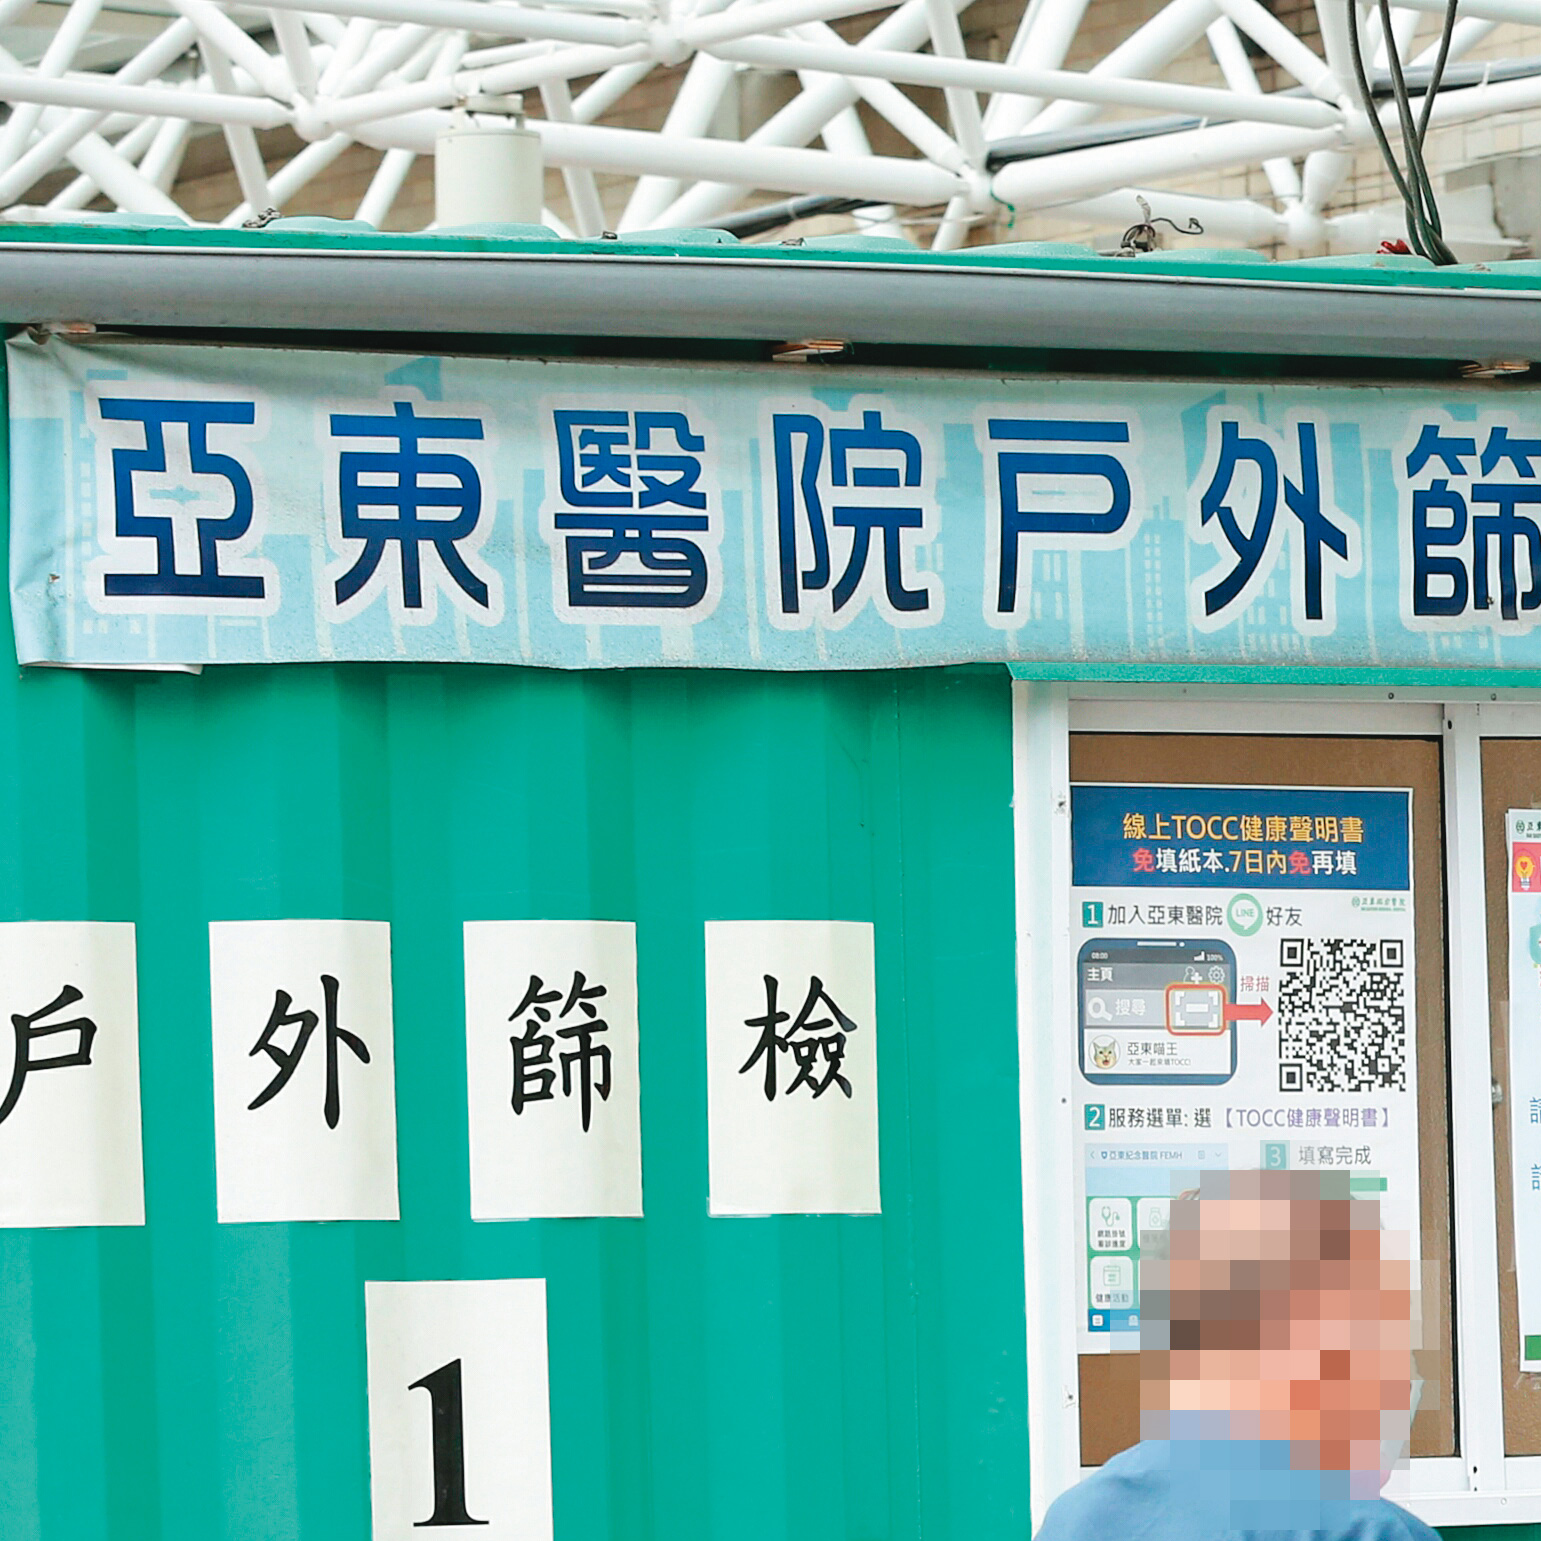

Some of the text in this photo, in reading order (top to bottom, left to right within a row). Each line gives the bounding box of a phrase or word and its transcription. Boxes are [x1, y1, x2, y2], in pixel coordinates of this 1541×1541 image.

[1122, 813, 1365, 843] 線上TOCC健康聲明書
[1107, 904, 1225, 927] 加入亞東醫院
[1236, 909, 1255, 919] LINE
[1266, 906, 1304, 928] 好友
[1087, 967, 1114, 982] 主頁
[1240, 975, 1271, 993] 掃描
[1115, 998, 1146, 1016] 搜尋
[0, 970, 858, 1133] 戶外篩檢
[1160, 1151, 1183, 1160] FEMH
[1298, 1145, 1372, 1165] 填寫完成
[407, 1358, 490, 1527] 1
